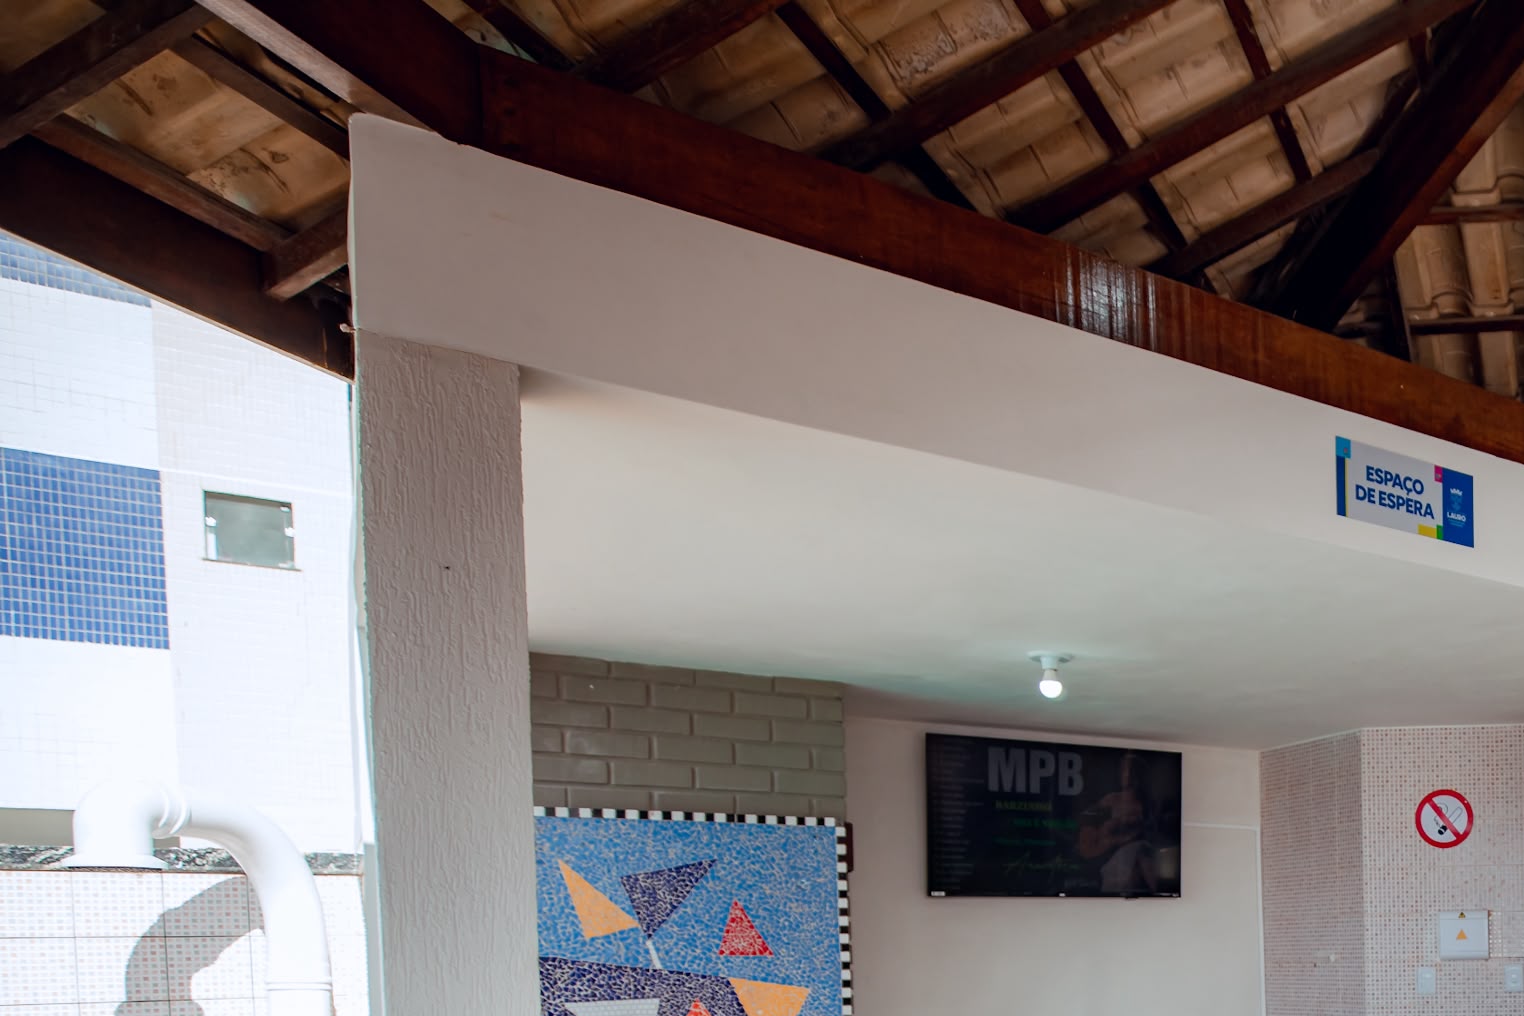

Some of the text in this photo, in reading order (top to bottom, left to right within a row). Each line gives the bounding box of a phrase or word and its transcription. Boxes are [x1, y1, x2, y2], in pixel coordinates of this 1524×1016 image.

[1366, 465, 1424, 496] ESPAÇO
[1355, 484, 1435, 520] DE ESPERA
[987, 747, 1083, 796] MPB
